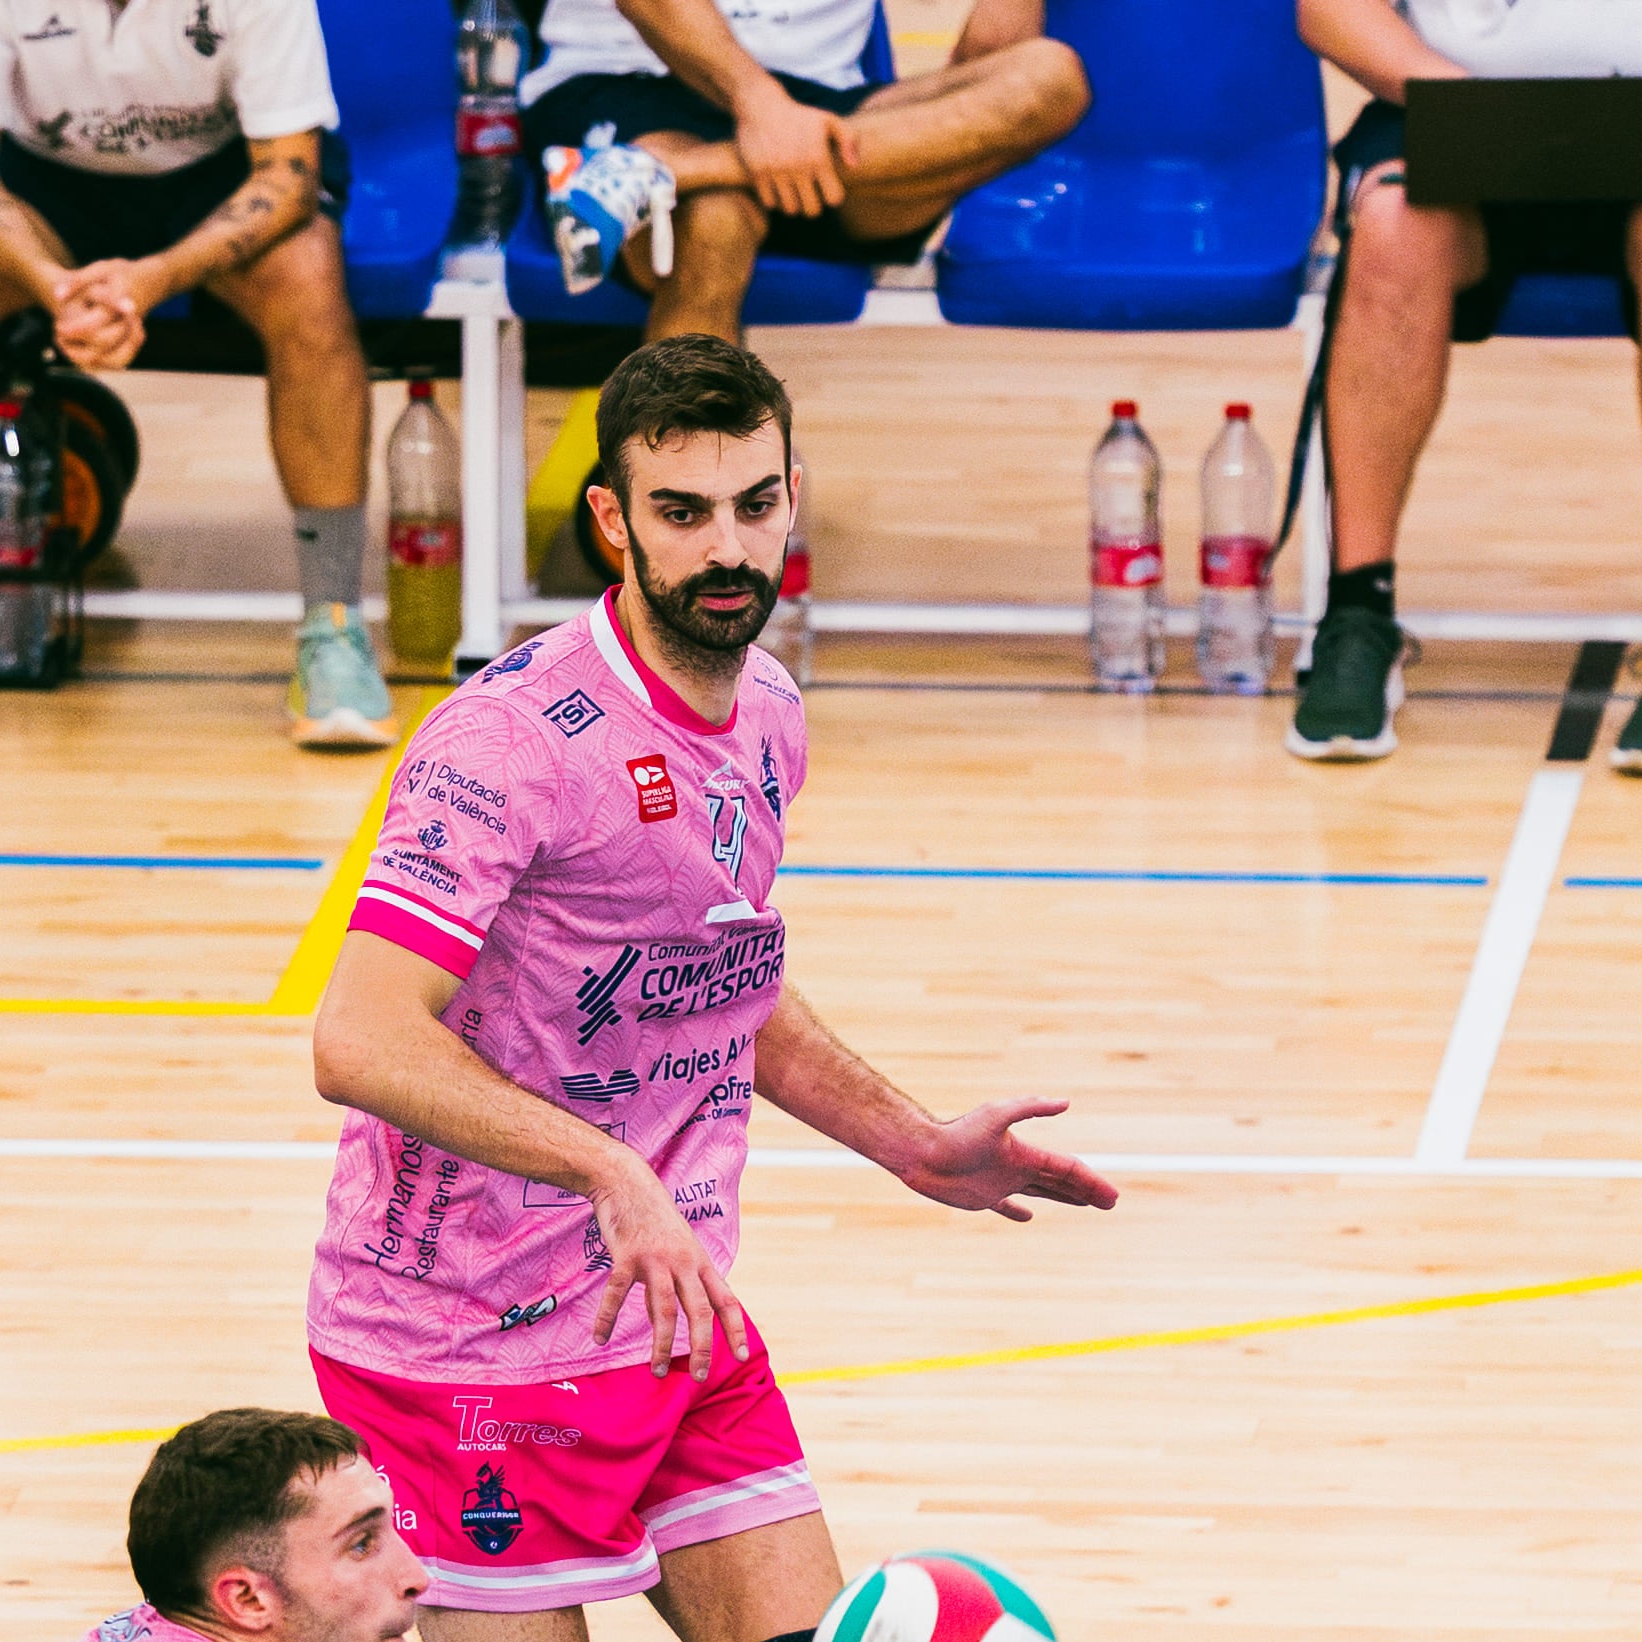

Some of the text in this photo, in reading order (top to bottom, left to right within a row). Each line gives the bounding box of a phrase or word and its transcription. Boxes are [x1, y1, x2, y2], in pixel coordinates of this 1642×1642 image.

[427, 785, 507, 835] de València
[437, 764, 507, 808] Diputació
[636, 996, 685, 1023] DE
[401, 1158, 459, 1280] Restaurante
[452, 1395, 582, 1447] Torres
